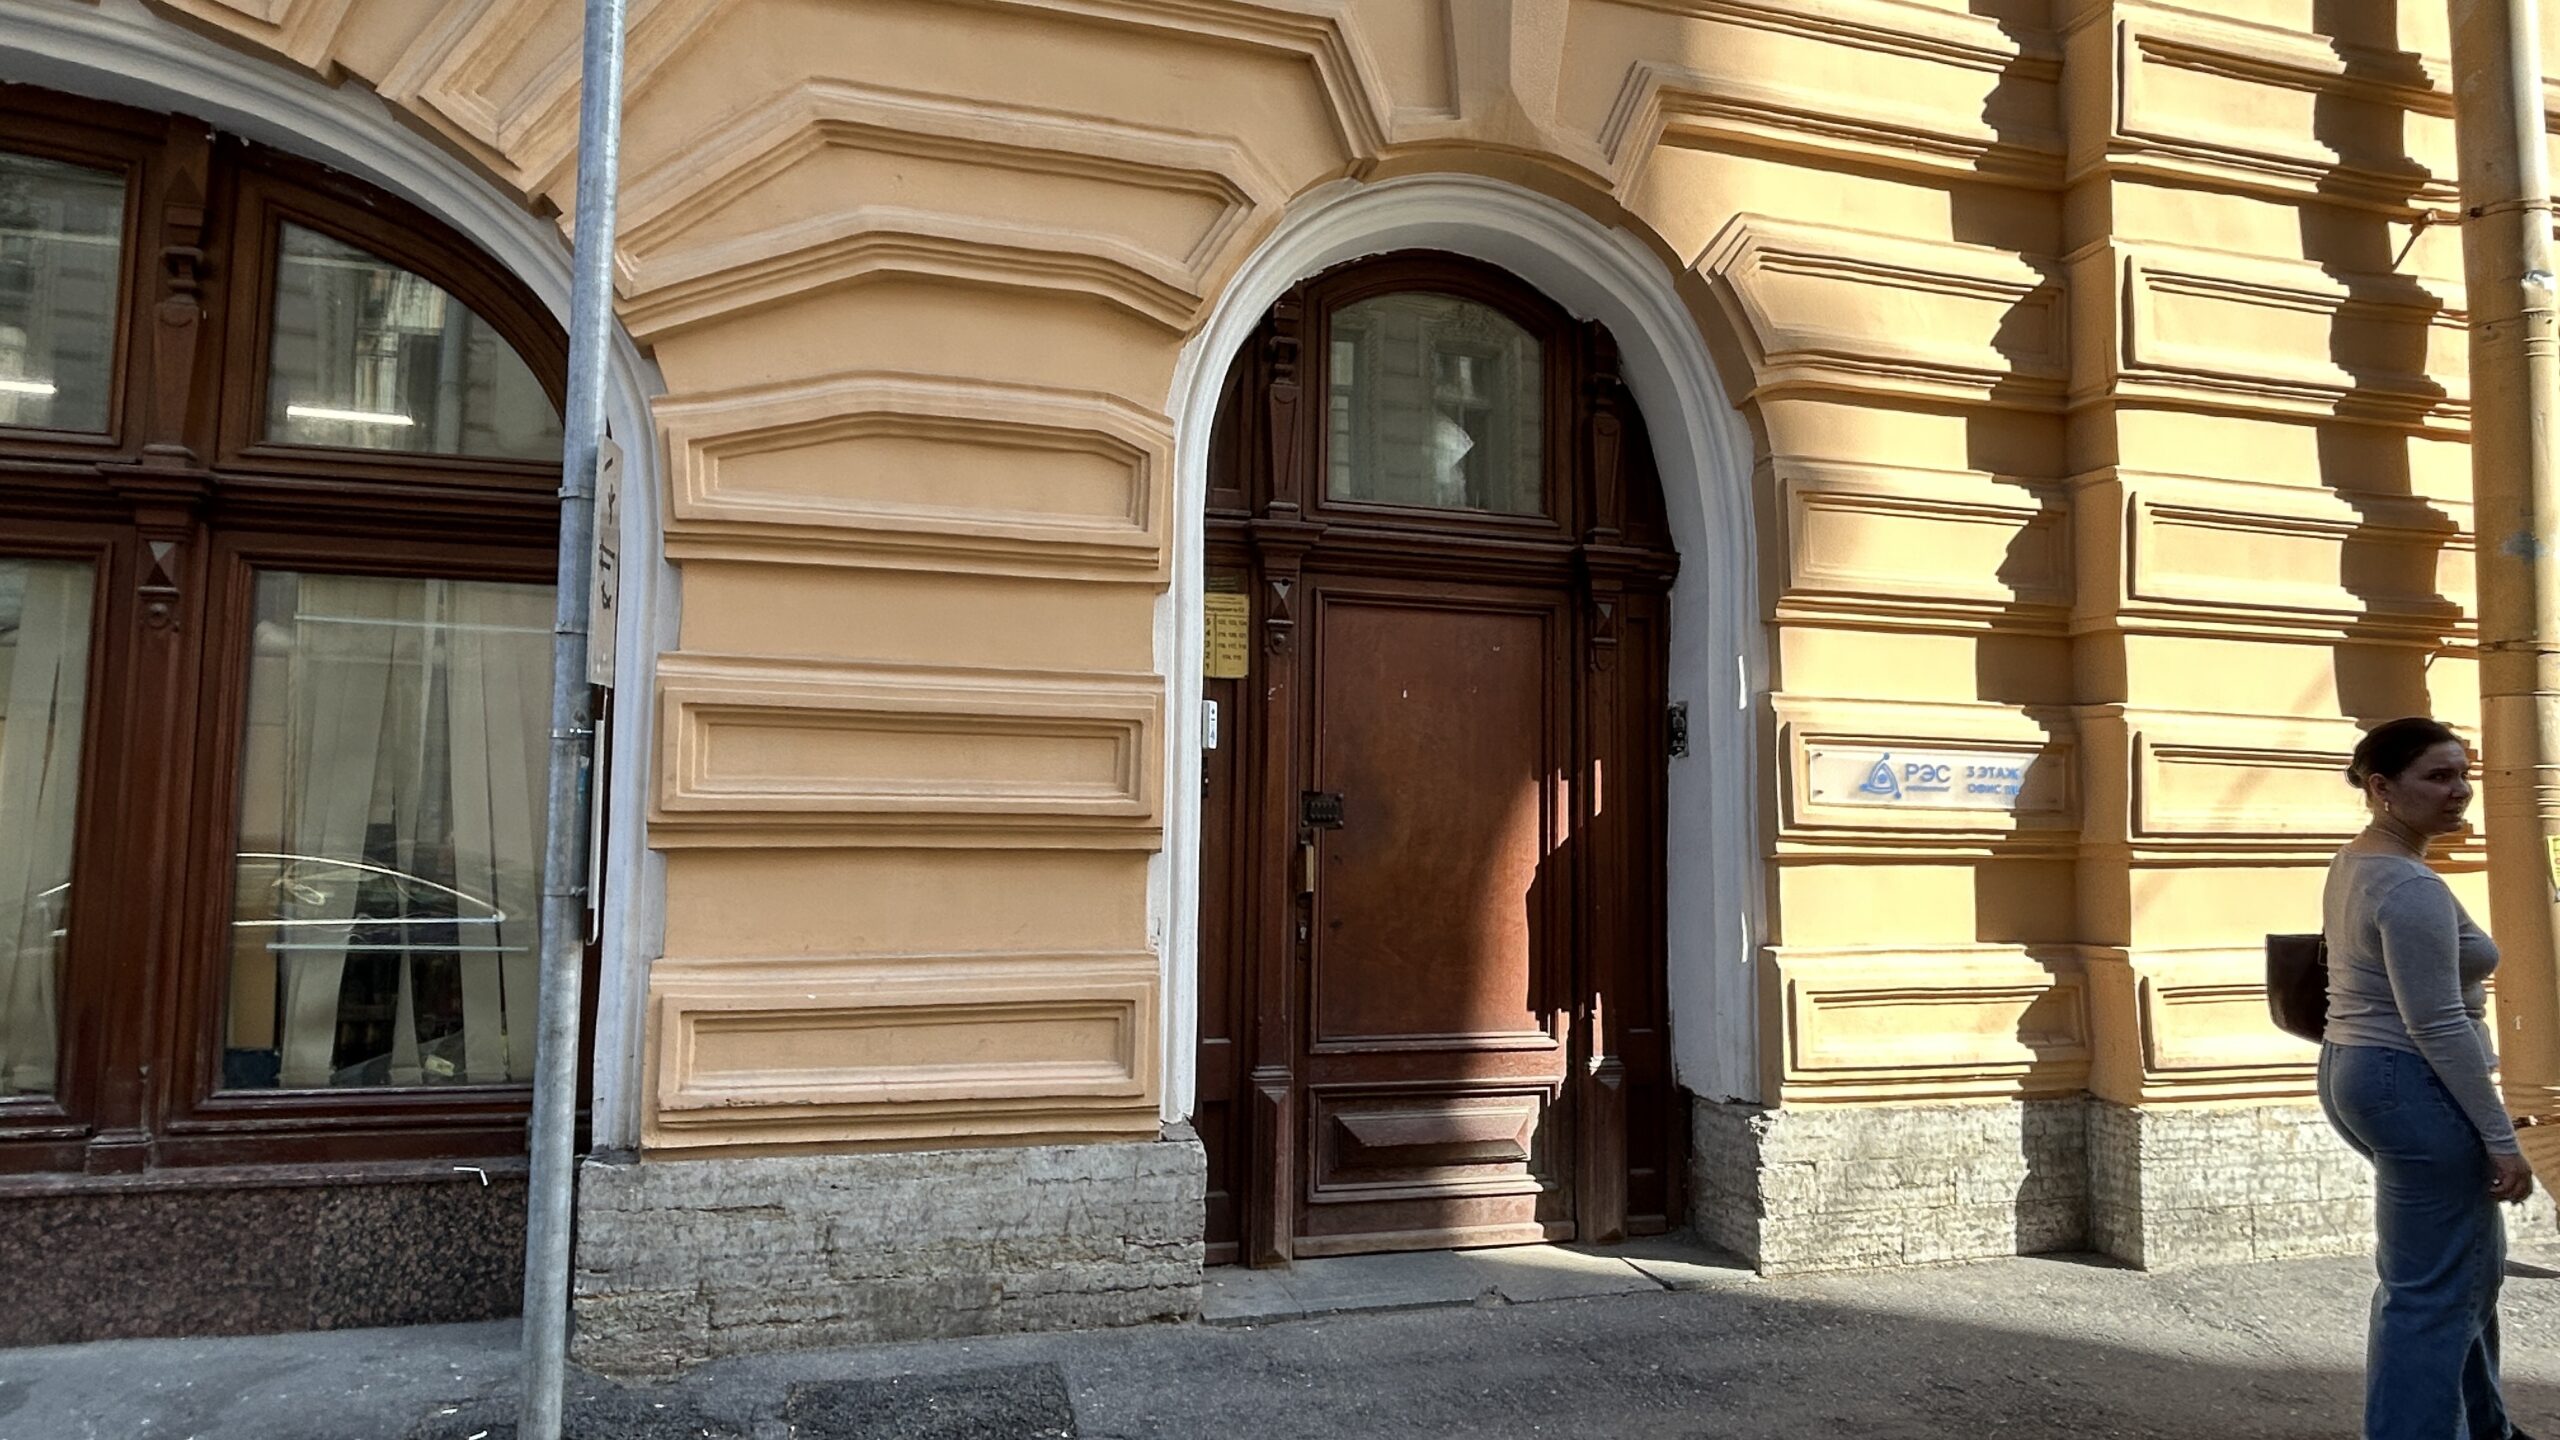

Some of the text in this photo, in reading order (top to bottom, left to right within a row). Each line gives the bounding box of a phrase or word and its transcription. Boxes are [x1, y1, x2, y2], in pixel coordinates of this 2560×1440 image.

[1905, 763, 1950, 783] РЭС
[1966, 765, 2020, 780] 3 ЭТАЖ
[1967, 784, 2002, 794] ОФИС
